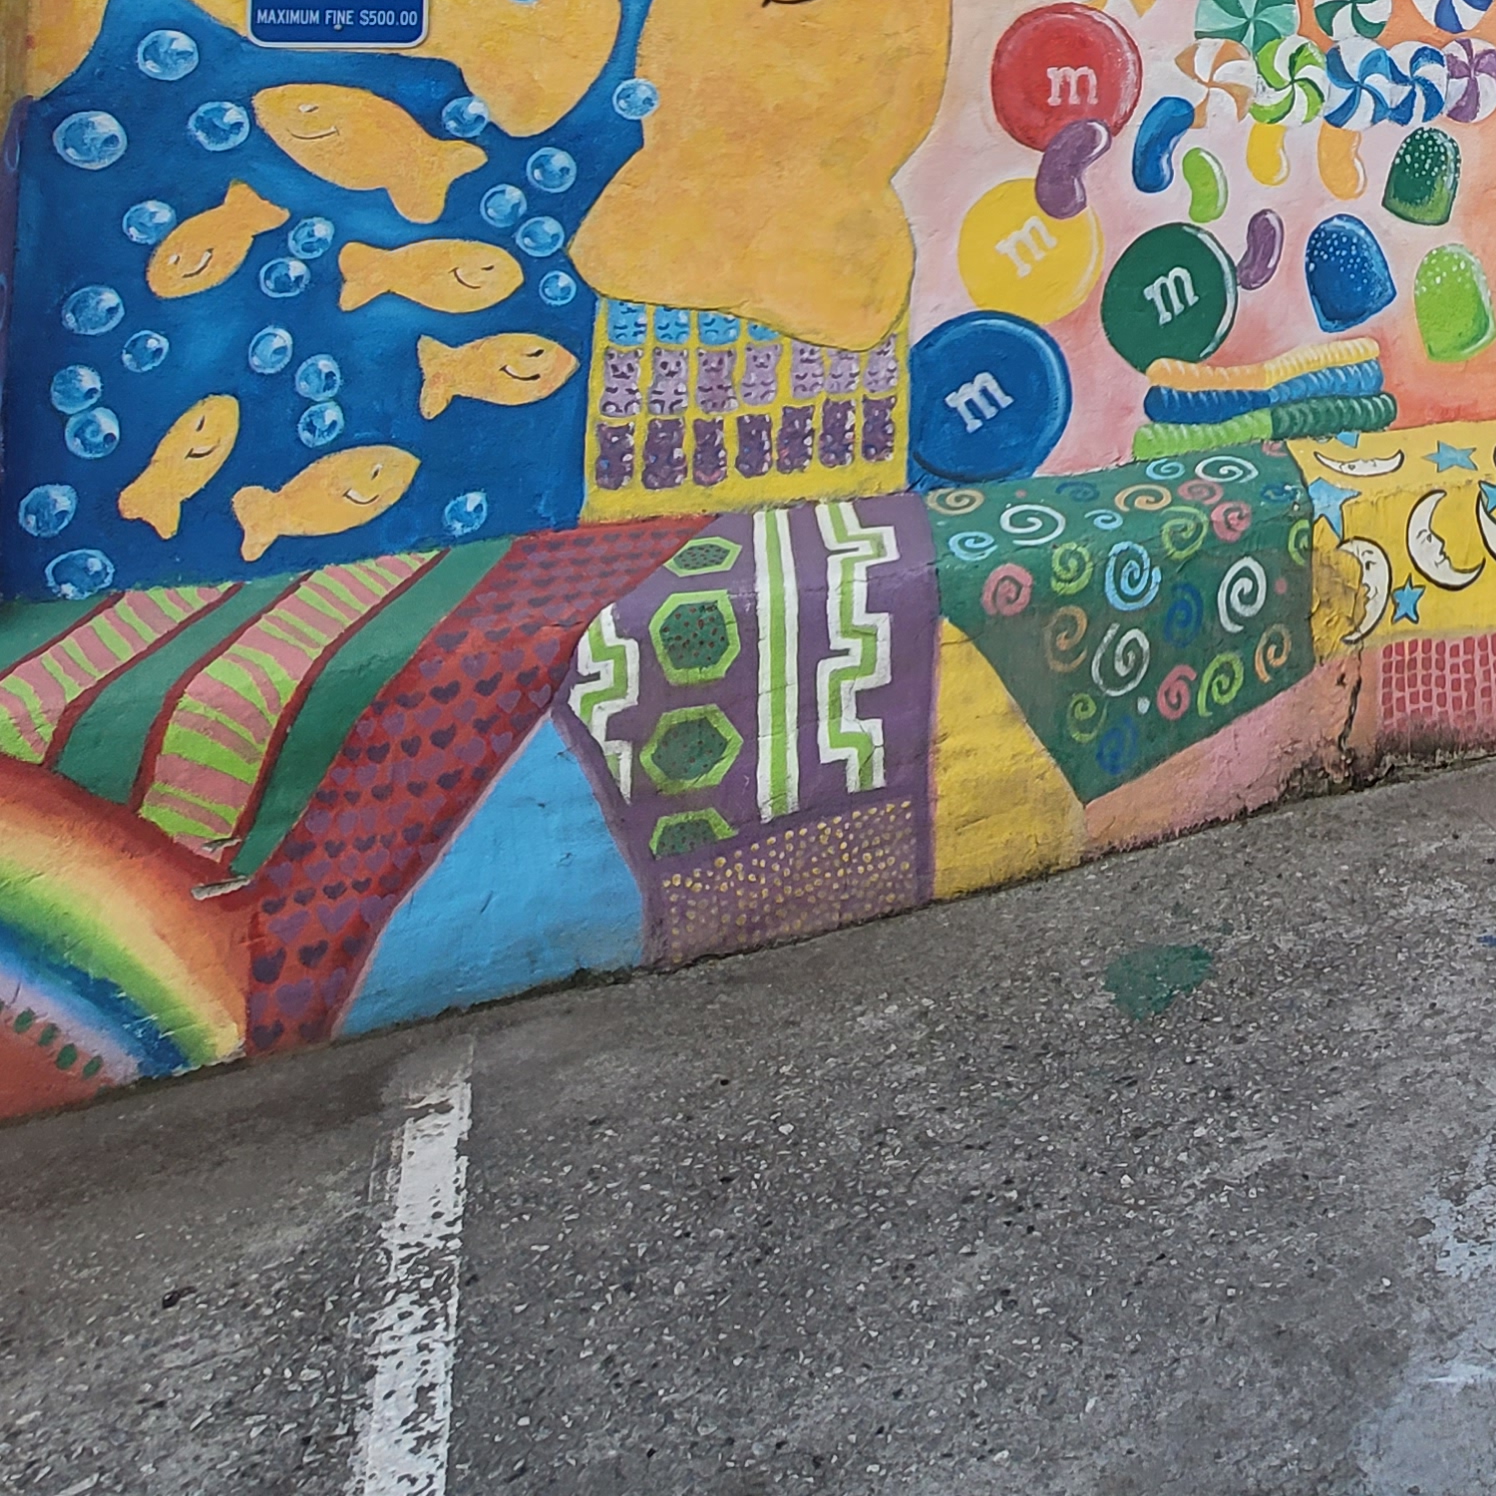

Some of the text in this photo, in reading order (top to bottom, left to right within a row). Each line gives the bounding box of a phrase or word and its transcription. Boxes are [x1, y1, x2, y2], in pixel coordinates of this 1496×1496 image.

[256, 9, 418, 26] MAXIMUM FINE $500.00
